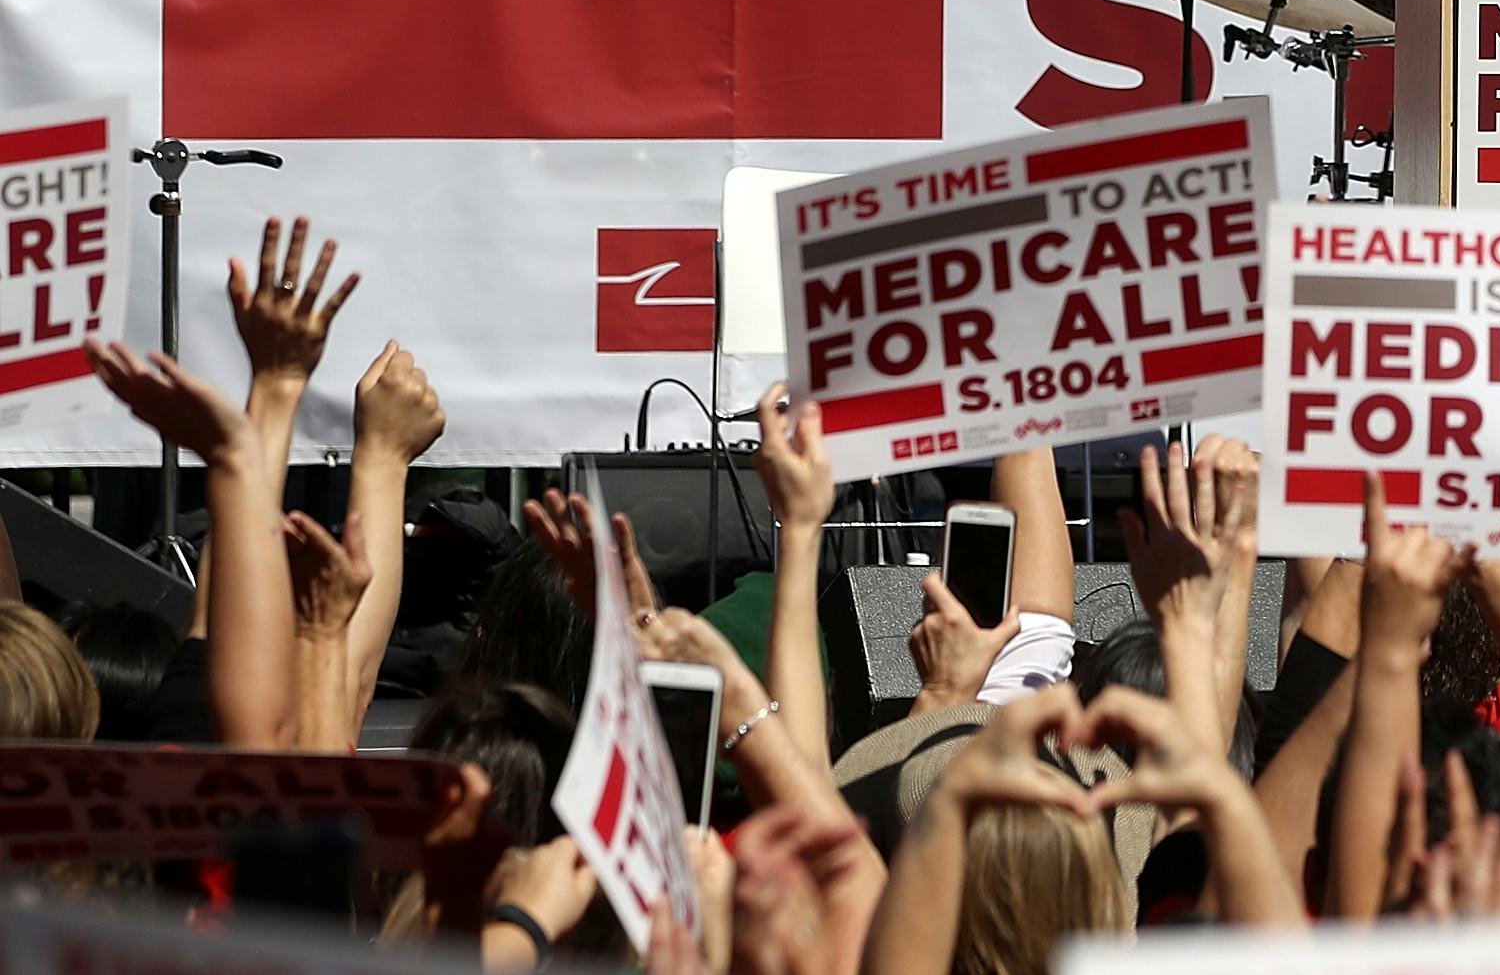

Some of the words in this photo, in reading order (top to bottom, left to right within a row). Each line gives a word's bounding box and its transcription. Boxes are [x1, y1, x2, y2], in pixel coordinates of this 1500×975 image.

[1, 162, 109, 209] GHT!
[797, 189, 880, 233] IT'S
[897, 160, 1010, 209] TIME
[1061, 181, 1124, 218] TO
[1142, 160, 1253, 207] ACT!
[805, 201, 1258, 331] MEDICARE
[807, 307, 998, 392] FOR
[1049, 266, 1264, 351] ALL!
[958, 355, 1129, 414] S.1804
[1287, 392, 1484, 458] FOR
